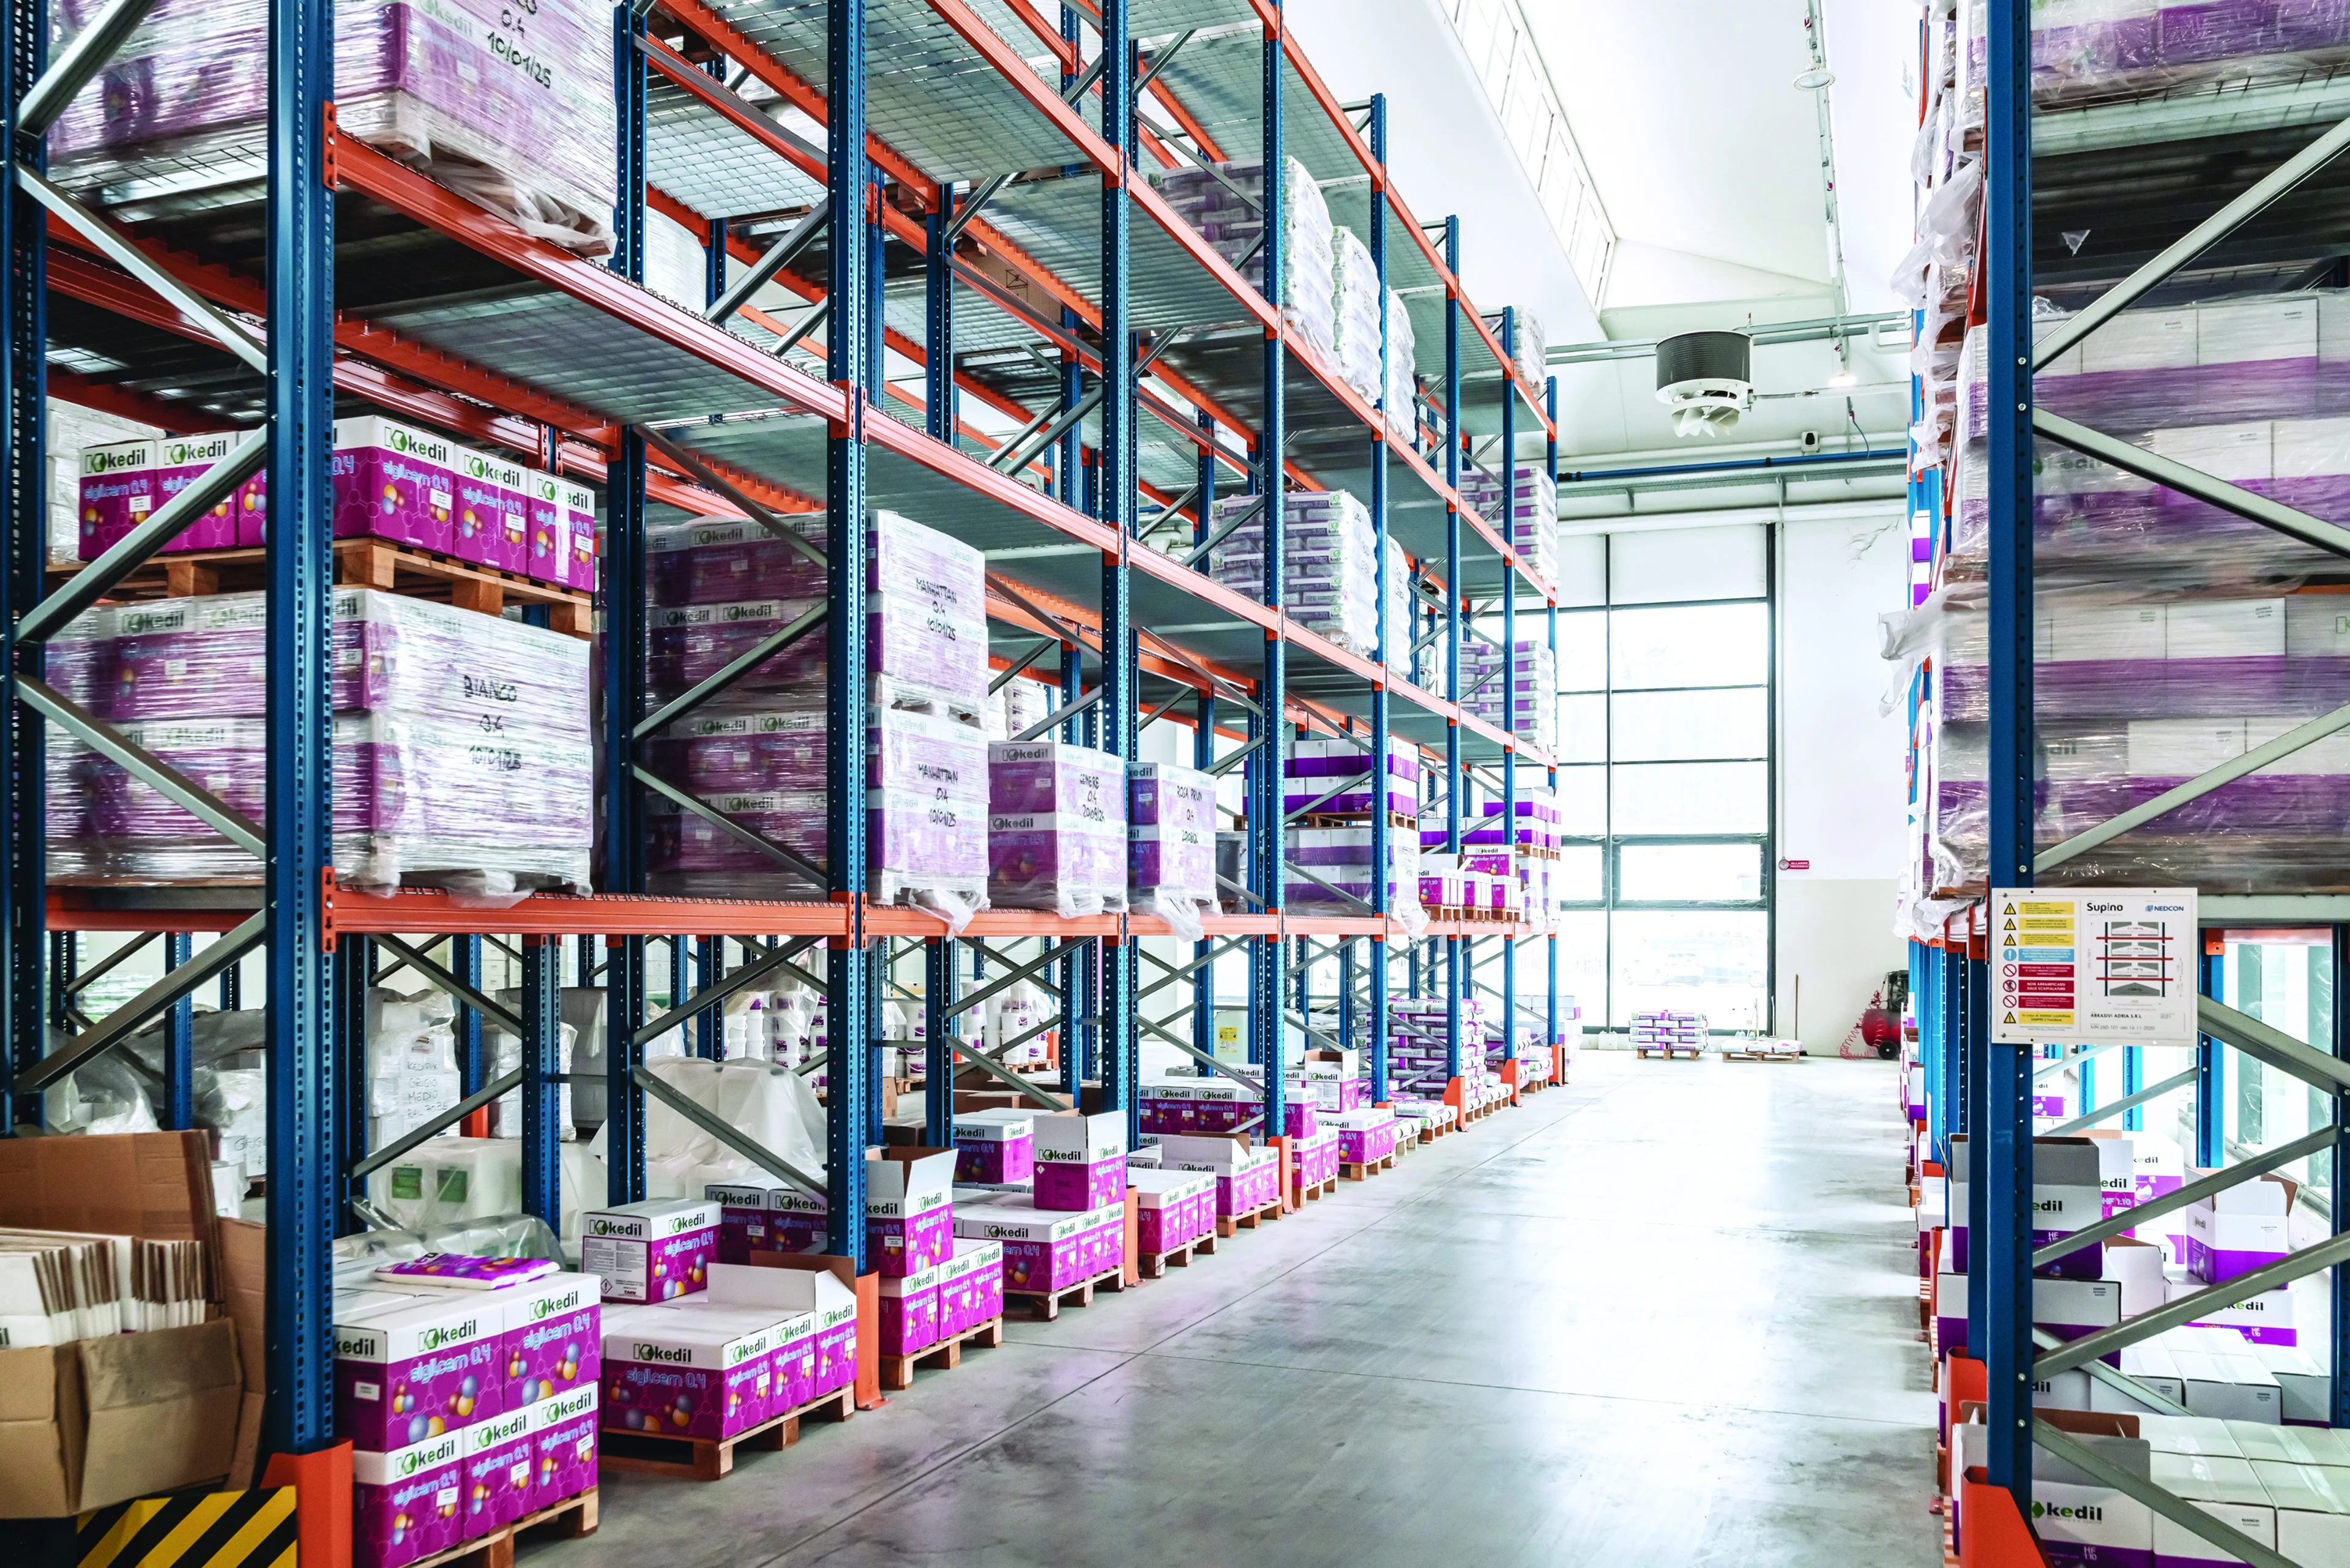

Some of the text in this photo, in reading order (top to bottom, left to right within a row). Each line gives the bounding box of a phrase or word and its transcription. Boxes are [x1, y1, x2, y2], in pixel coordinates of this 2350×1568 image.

[501, 9, 525, 39] 0.4
[488, 31, 551, 89] 10/01/25
[187, 440, 226, 460] kedil
[409, 435, 447, 462] kedil
[108, 449, 146, 468] kedil
[332, 455, 354, 475] 0.4
[485, 462, 520, 487] kedil
[130, 479, 147, 494] 0.4
[431, 474, 449, 492] 0.4
[506, 499, 522, 515] 0.4
[576, 521, 590, 536] 0.4
[712, 528, 742, 540] kedil
[741, 605, 771, 617] kedil
[933, 600, 946, 617] 0.4
[145, 611, 184, 629] kedil
[927, 618, 956, 641] 10/01/25
[464, 674, 517, 702] BIANCO
[1020, 748, 1048, 759] kedil
[919, 764, 958, 785] MANHATTAN
[936, 788, 949, 804] 0.4
[928, 808, 956, 827] 10/01/25
[1004, 818, 1034, 829] kedil
[1128, 829, 1140, 838] dil
[2087, 903, 2123, 913] Supino
[408, 1090, 438, 1103] MEDIO
[960, 1126, 985, 1137] kedil
[1012, 1127, 1024, 1135] kedil
[981, 1143, 994, 1153] 0.4
[1054, 1150, 1081, 1160] kedil
[1105, 1146, 1118, 1156] kedil
[2101, 1178, 2127, 1188] edil
[729, 1193, 759, 1205] kedil
[927, 1192, 942, 1206] kedil
[1169, 1191, 1179, 1201] kedil
[865, 1202, 898, 1214] kedil
[1111, 1207, 1122, 1217] kedil
[2033, 1200, 2062, 1211] edil
[682, 1212, 704, 1228] kedil
[939, 1209, 948, 1223] 0.4
[1088, 1214, 1100, 1225] kedil
[608, 1222, 641, 1236] kedil
[886, 1224, 900, 1234] 0.4
[1001, 1227, 1028, 1238] kedil
[1062, 1223, 1075, 1233] kedil
[701, 1231, 714, 1245] 0.4
[984, 1247, 1000, 1262] kedil
[1024, 1245, 1039, 1256] 0.4
[953, 1260, 969, 1274] kedil
[917, 1272, 934, 1287] kedil
[548, 1291, 578, 1313] kedil
[833, 1304, 852, 1322] kedil
[573, 1312, 590, 1332] 0.4
[789, 1320, 810, 1338] kedil
[441, 1320, 476, 1343] kedil
[845, 1326, 854, 1336] 0.4
[332, 1335, 375, 1356] kedil
[744, 1337, 766, 1357] kedil
[802, 1342, 812, 1355] 0.4
[471, 1343, 491, 1364] 0.4
[655, 1346, 692, 1362] kedil
[758, 1361, 768, 1374] 0.4
[686, 1372, 706, 1389] 0.4
[561, 1392, 591, 1416] kedil
[494, 1416, 527, 1441] kedil
[580, 1419, 593, 1436] 0.4
[419, 1439, 454, 1466] kedil
[514, 1443, 529, 1460] 0.4
[440, 1469, 457, 1489] 0.4
[2046, 1503, 2102, 1521] kedil
[2084, 1546, 2097, 1555] HF
